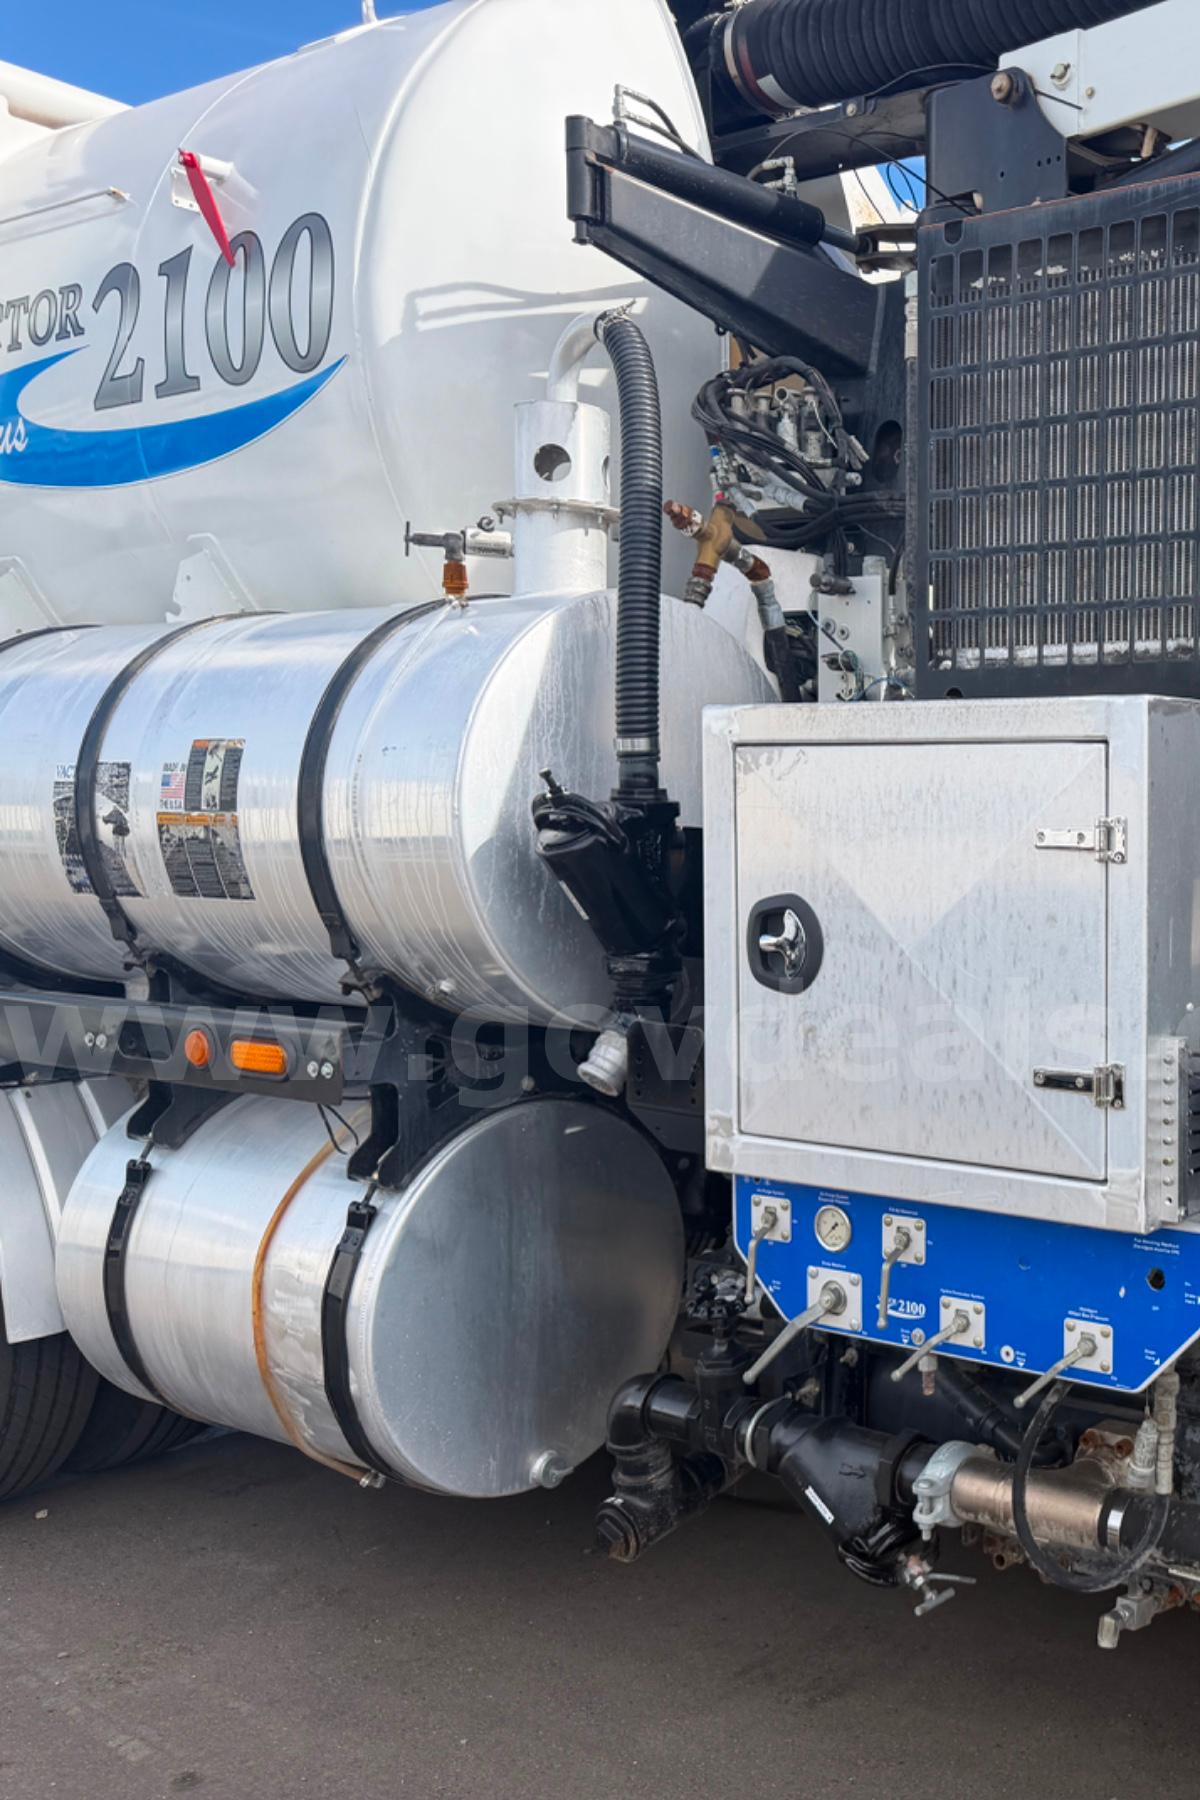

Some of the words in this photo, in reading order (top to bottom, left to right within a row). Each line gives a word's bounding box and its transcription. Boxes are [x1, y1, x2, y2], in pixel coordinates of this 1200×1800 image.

[0, 283, 85, 352] TOR
[92, 212, 334, 411] 2100
[898, 1299, 926, 1316] 2100
